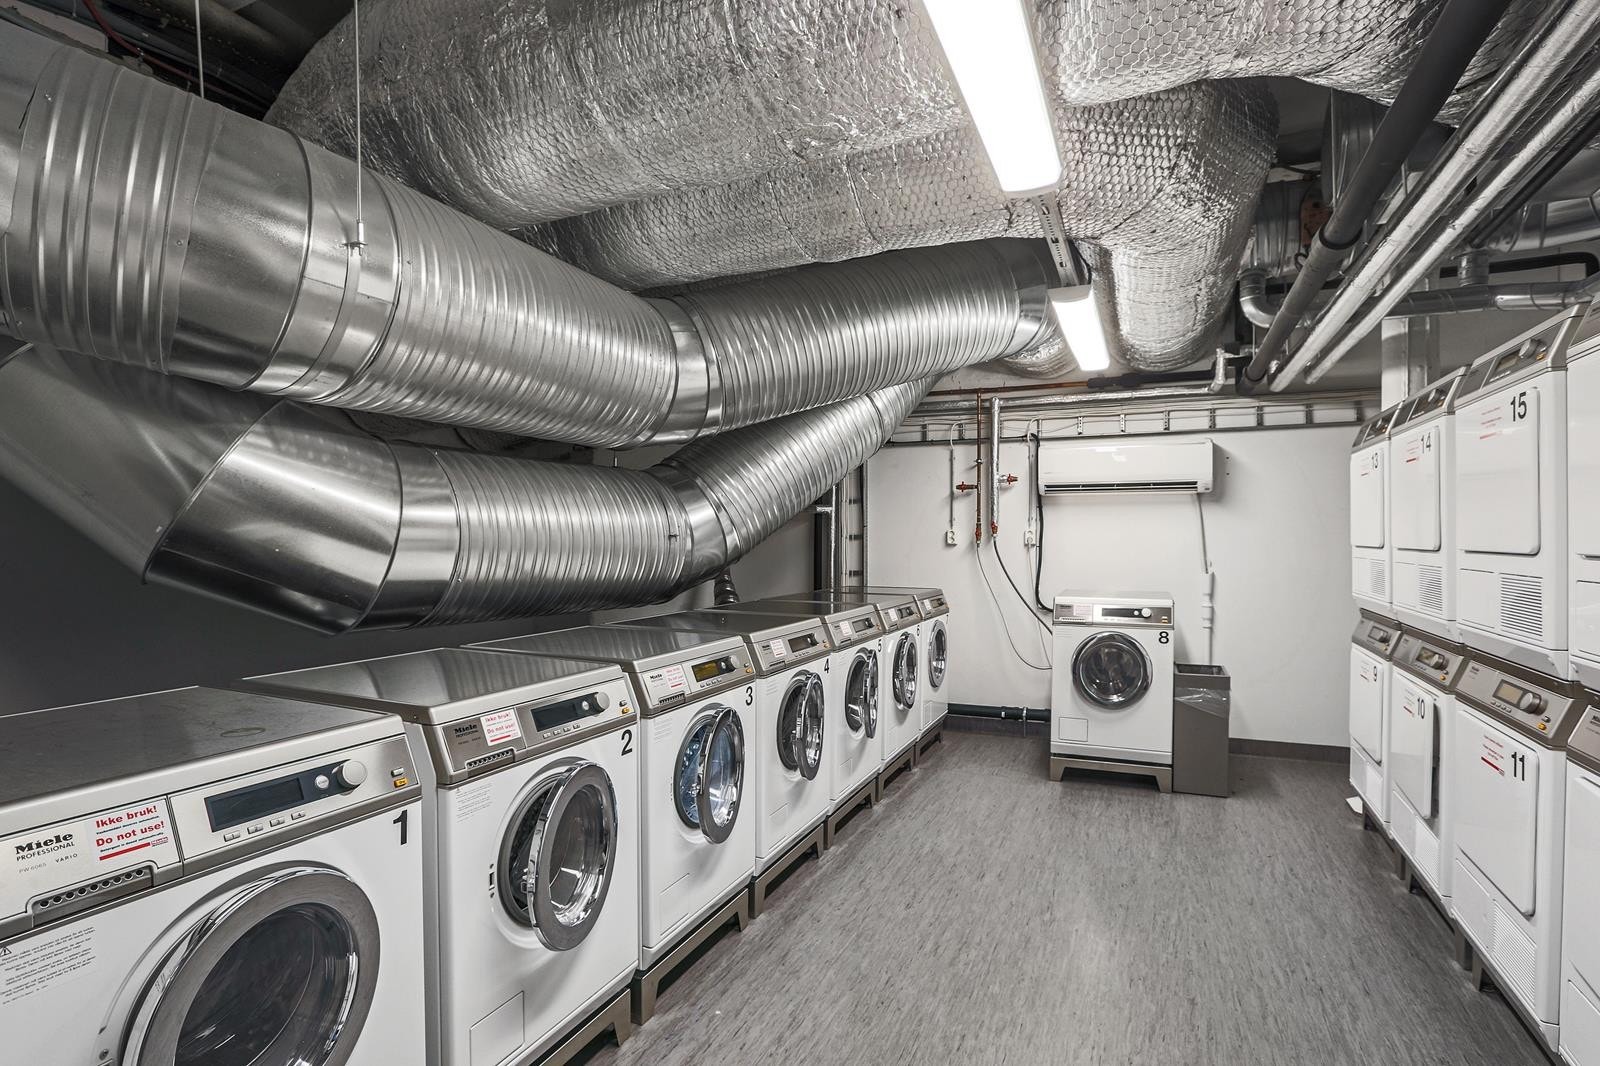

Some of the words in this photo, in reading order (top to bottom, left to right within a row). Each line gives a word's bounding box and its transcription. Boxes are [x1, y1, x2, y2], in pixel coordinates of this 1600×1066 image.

[1510, 391, 1527, 422] 15
[1421, 432, 1431, 454] 14
[1371, 452, 1378, 469] 13
[916, 624, 920, 636] 6
[1158, 631, 1169, 644] 8
[877, 639, 882, 652] 5
[823, 658, 830, 674] 4
[1373, 666, 1378, 682] 9
[745, 686, 753, 706] 3
[1417, 697, 1425, 719] 10
[454, 724, 478, 735] Miele
[621, 729, 633, 756] 2
[1511, 751, 1525, 781] 11
[95, 815, 123, 829] Ikke
[126, 805, 158, 820] bruk!
[393, 809, 408, 846] 1
[15, 833, 74, 855] Miele
[95, 836, 113, 847] Do
[117, 830, 137, 841] not
[140, 820, 165, 834] use!
[16, 841, 75, 862] PROFESSIONAL
[55, 853, 78, 863] VARIO
